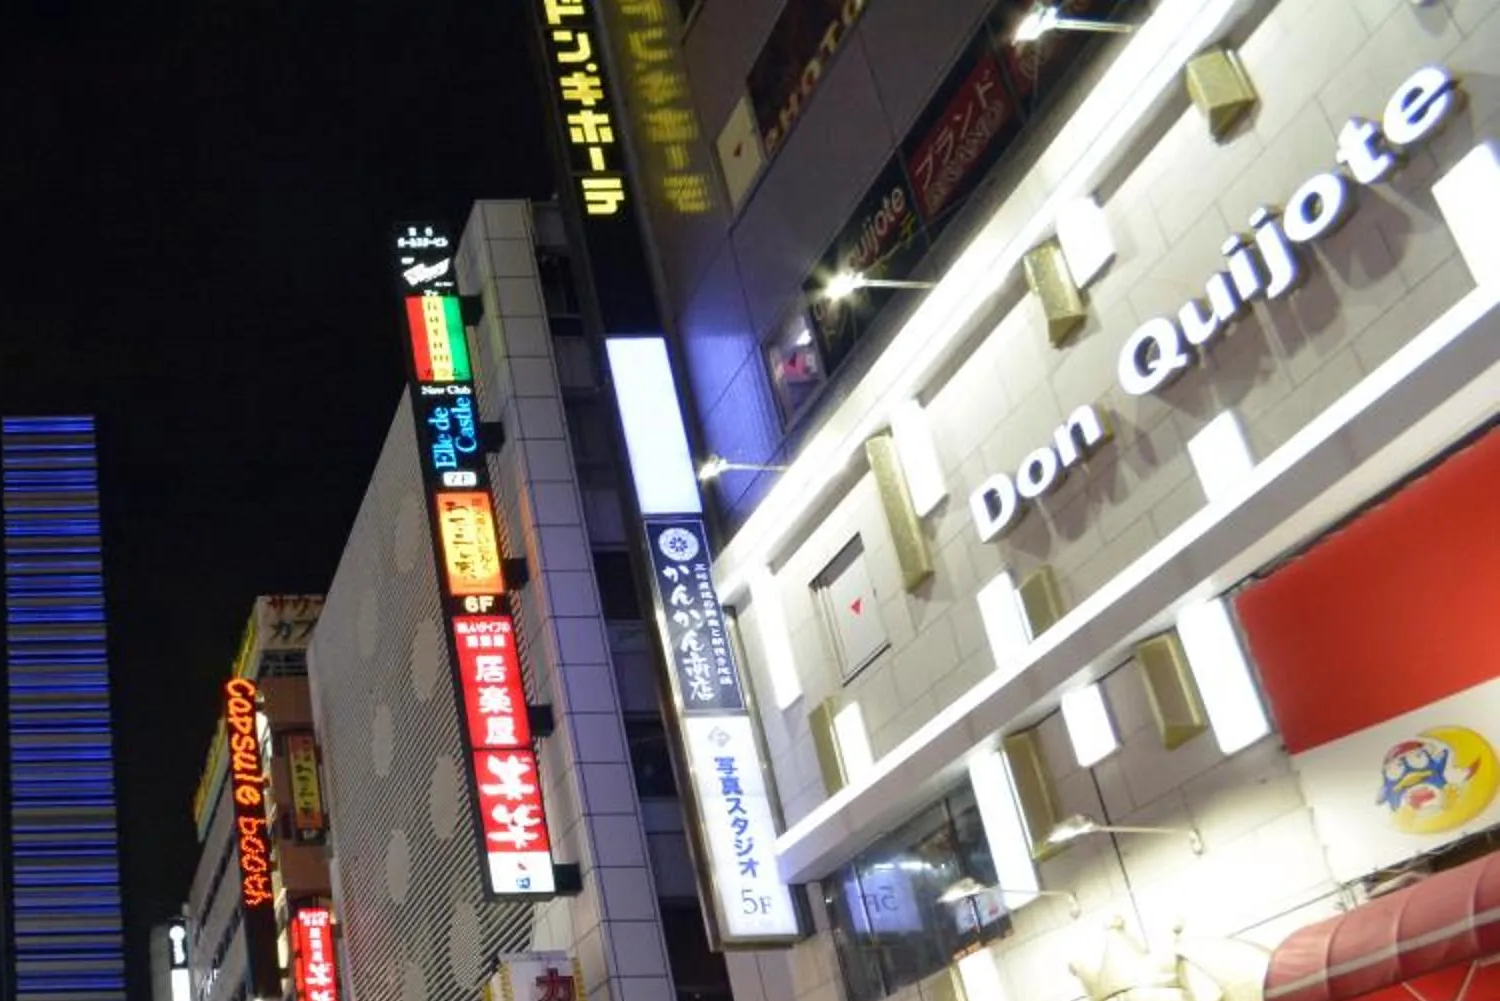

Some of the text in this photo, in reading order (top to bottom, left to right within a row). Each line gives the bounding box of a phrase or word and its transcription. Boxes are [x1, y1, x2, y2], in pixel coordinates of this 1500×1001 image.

[970, 404, 1106, 543] Don
[1119, 66, 1458, 396] Quijote
[451, 396, 477, 453] Castle
[464, 595, 495, 613] 6F
[713, 755, 761, 879] 写真スタジオ
[740, 888, 772, 916] 5F
